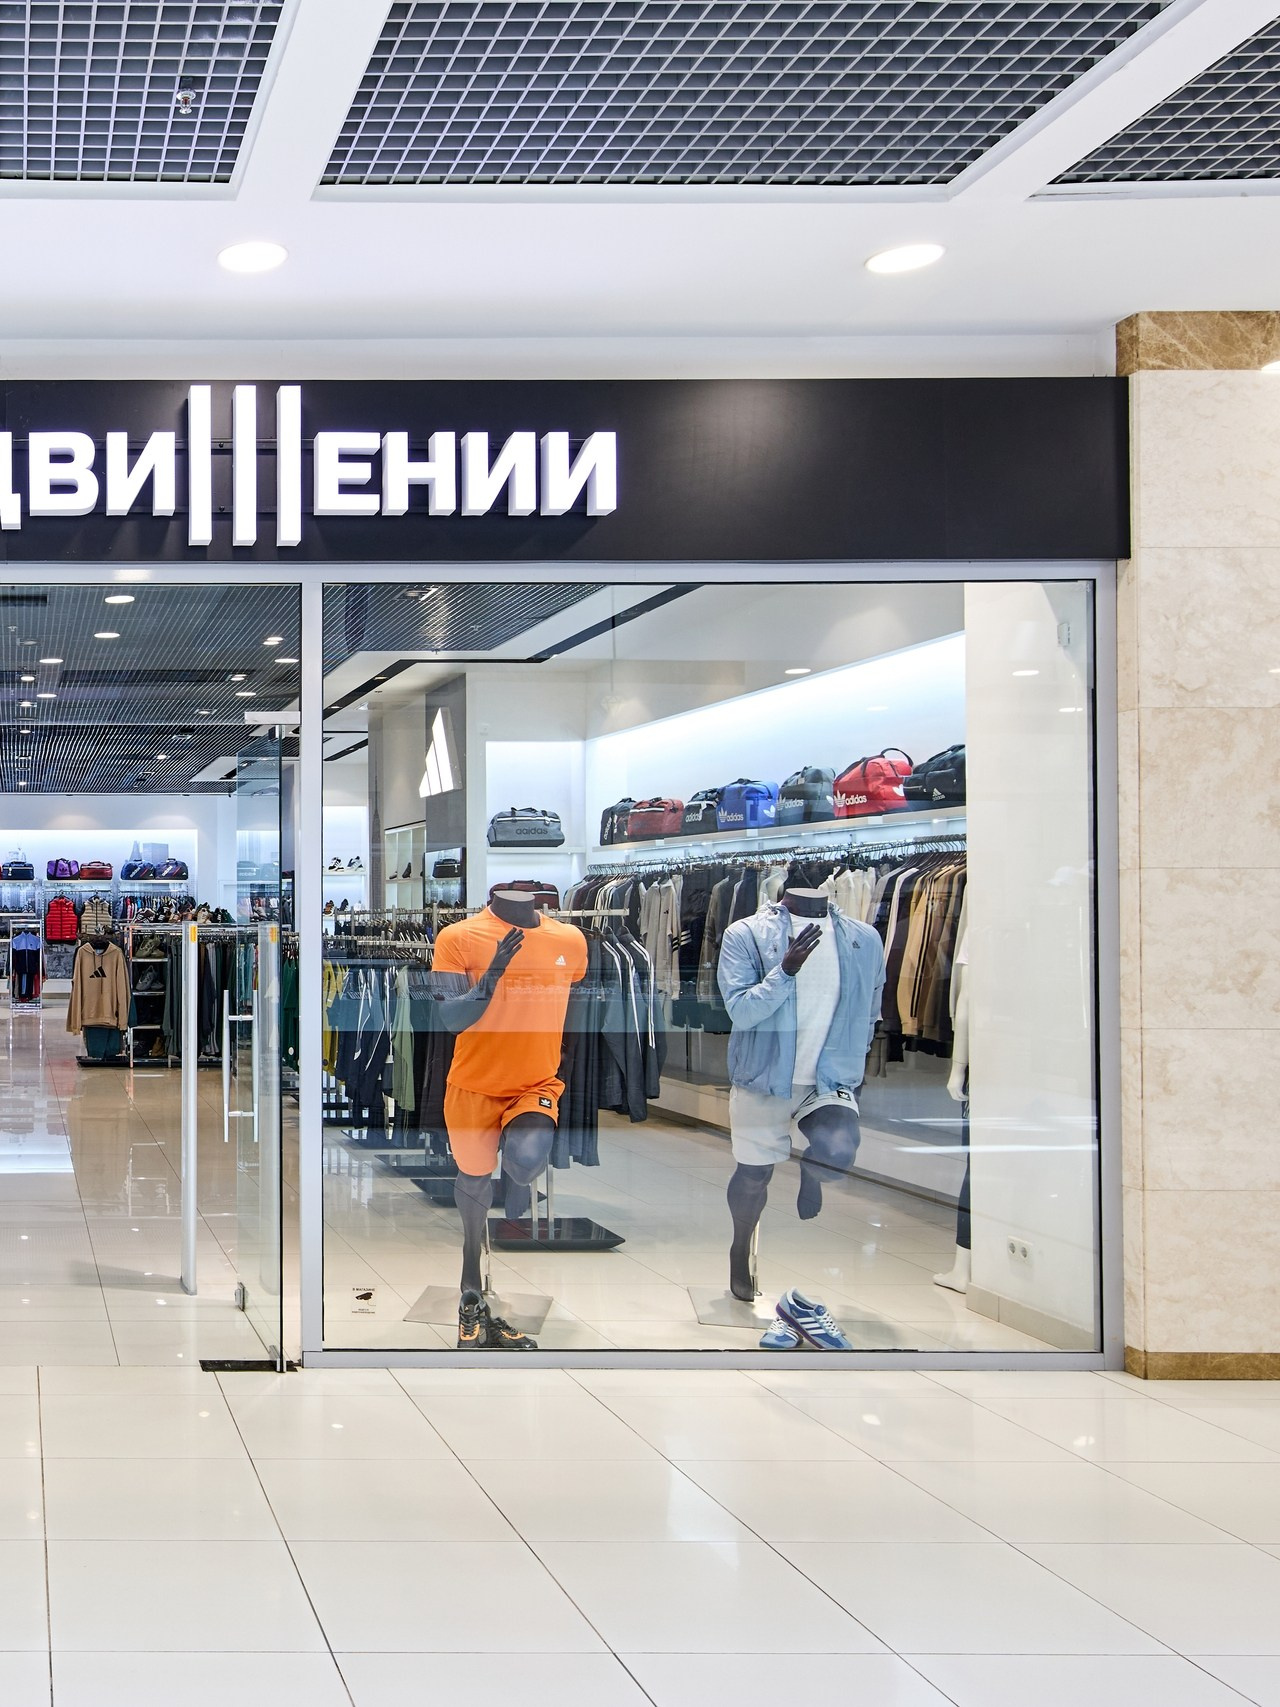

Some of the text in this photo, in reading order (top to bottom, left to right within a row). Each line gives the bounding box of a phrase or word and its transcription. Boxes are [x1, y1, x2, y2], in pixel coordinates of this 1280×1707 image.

[785, 799, 804, 808] adidas
[846, 795, 867, 805] adidas
[726, 812, 744, 822] adidas
